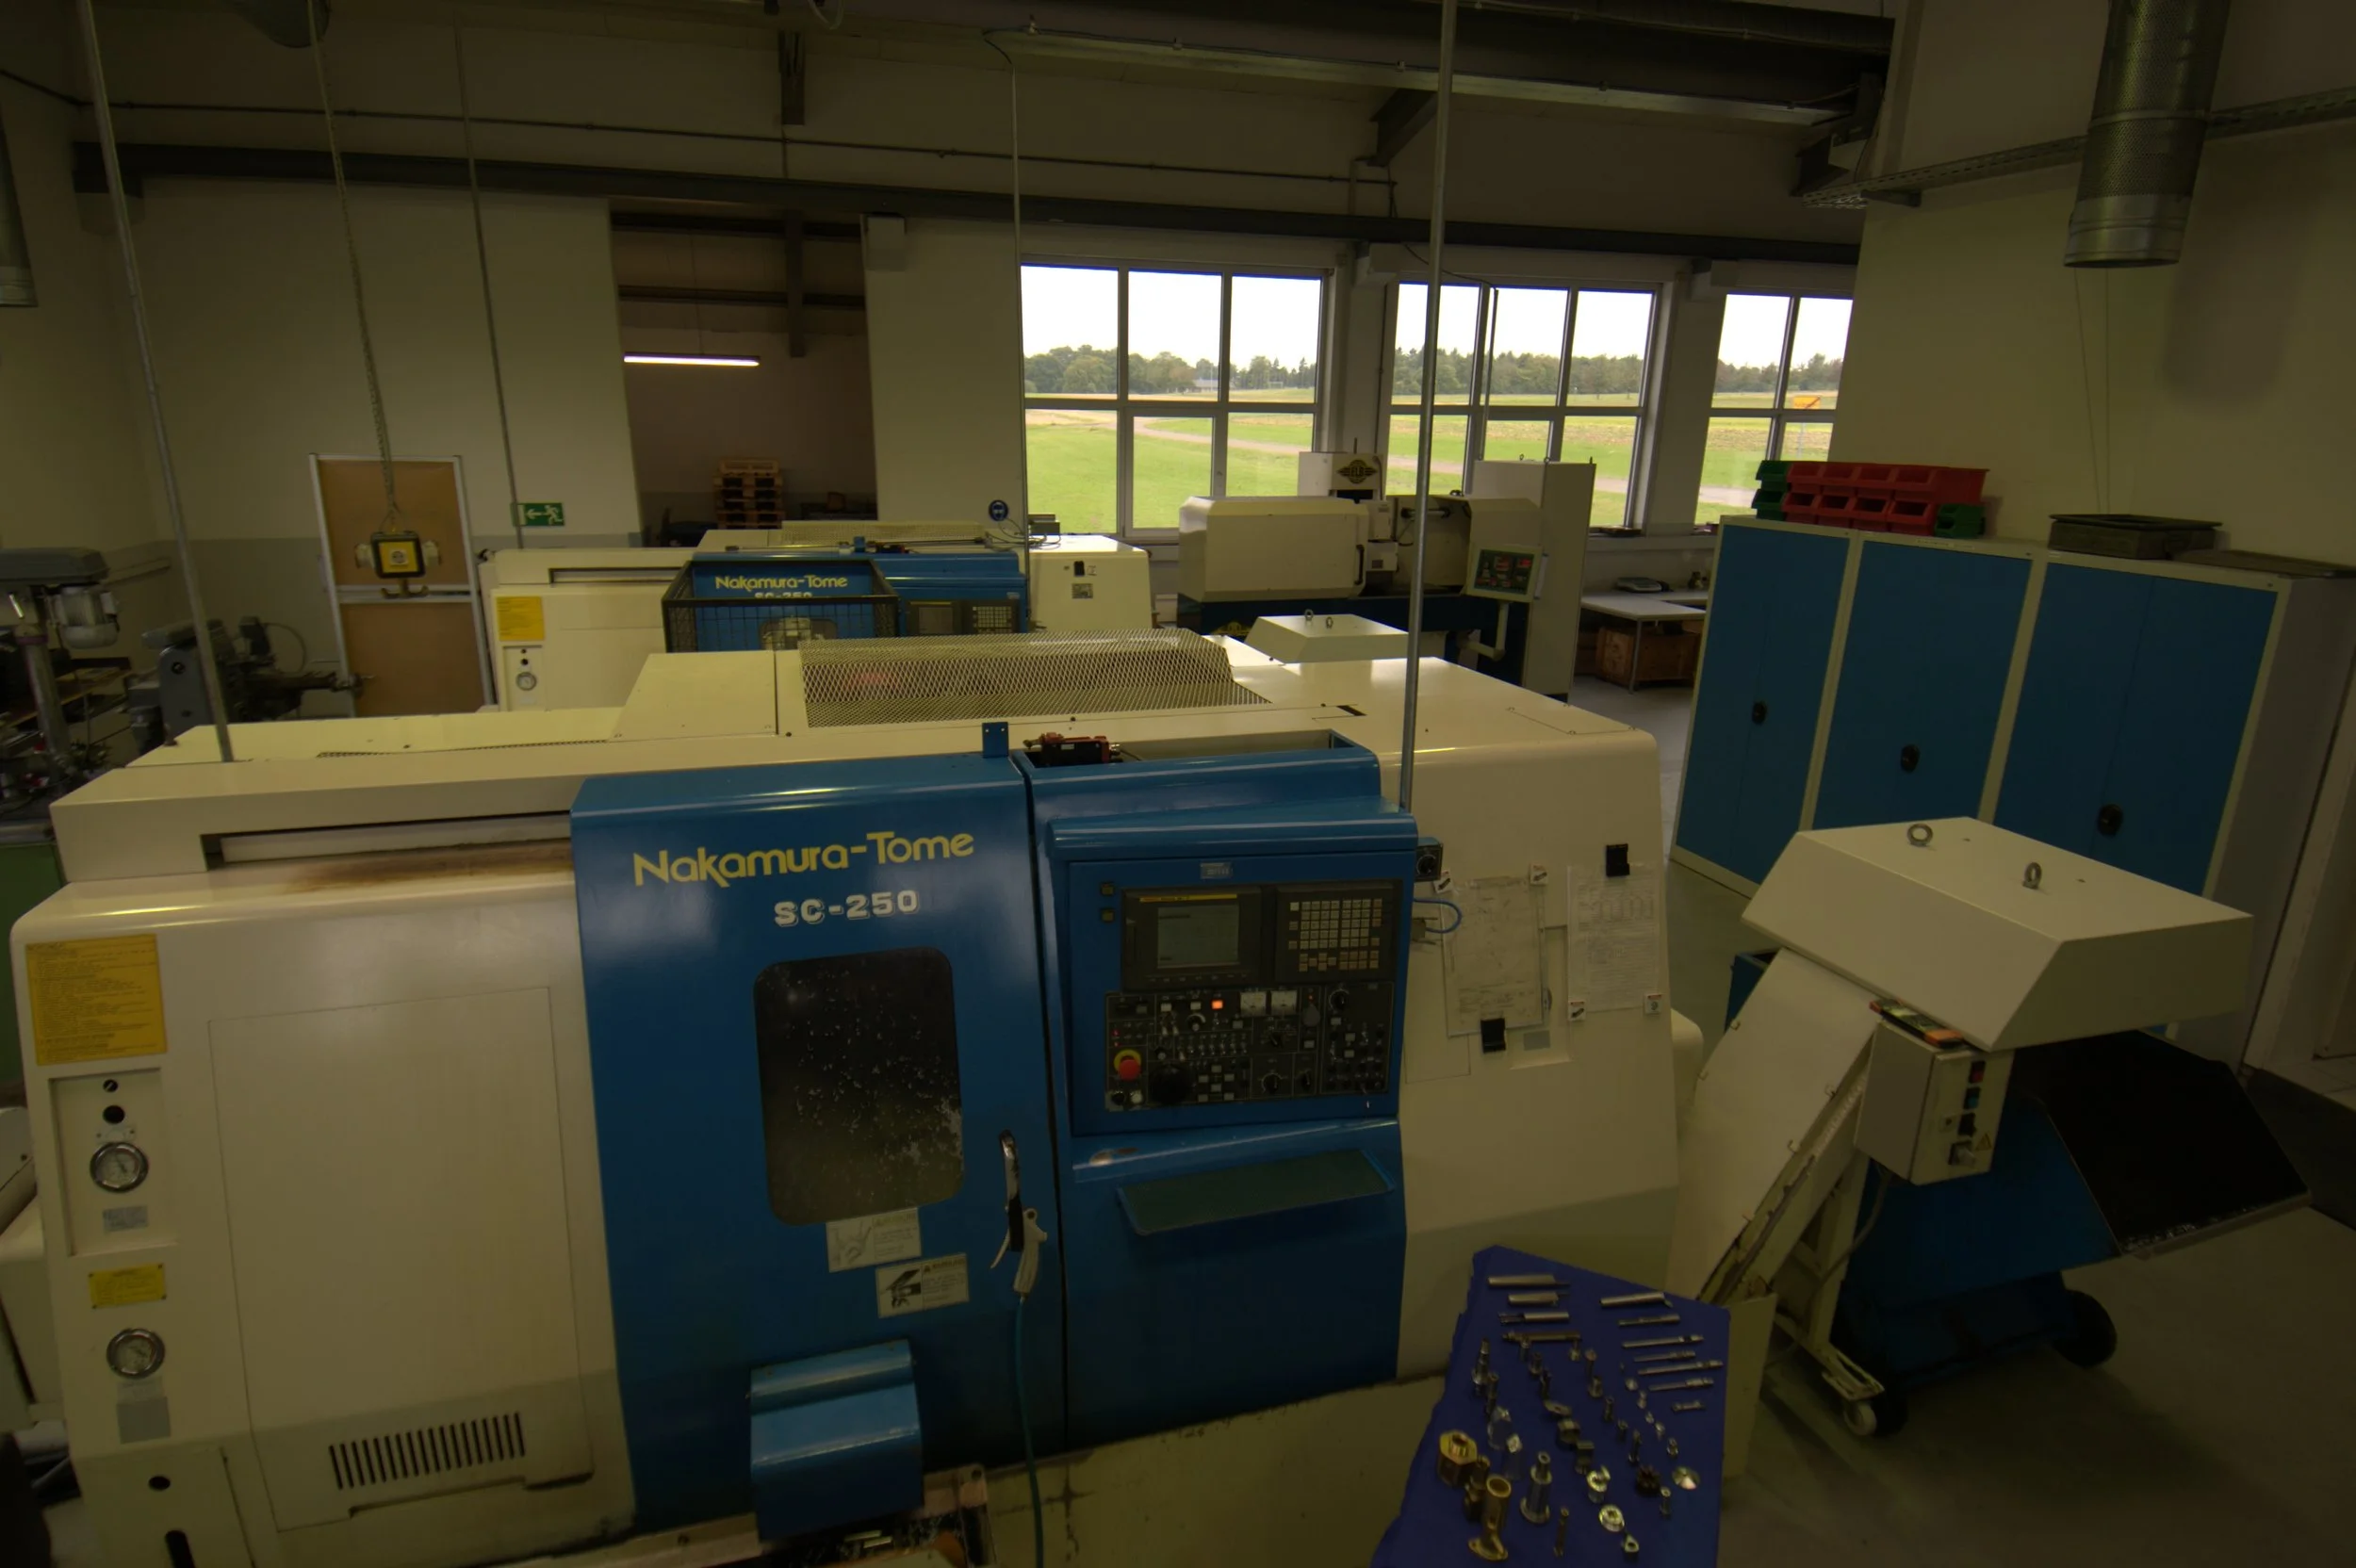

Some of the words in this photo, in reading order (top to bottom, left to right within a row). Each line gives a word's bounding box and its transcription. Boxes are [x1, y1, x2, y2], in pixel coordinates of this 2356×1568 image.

[714, 574, 847, 593] Nakamura-Tome
[632, 831, 974, 888] Nakamura-Tome
[774, 890, 920, 927] SC-250
